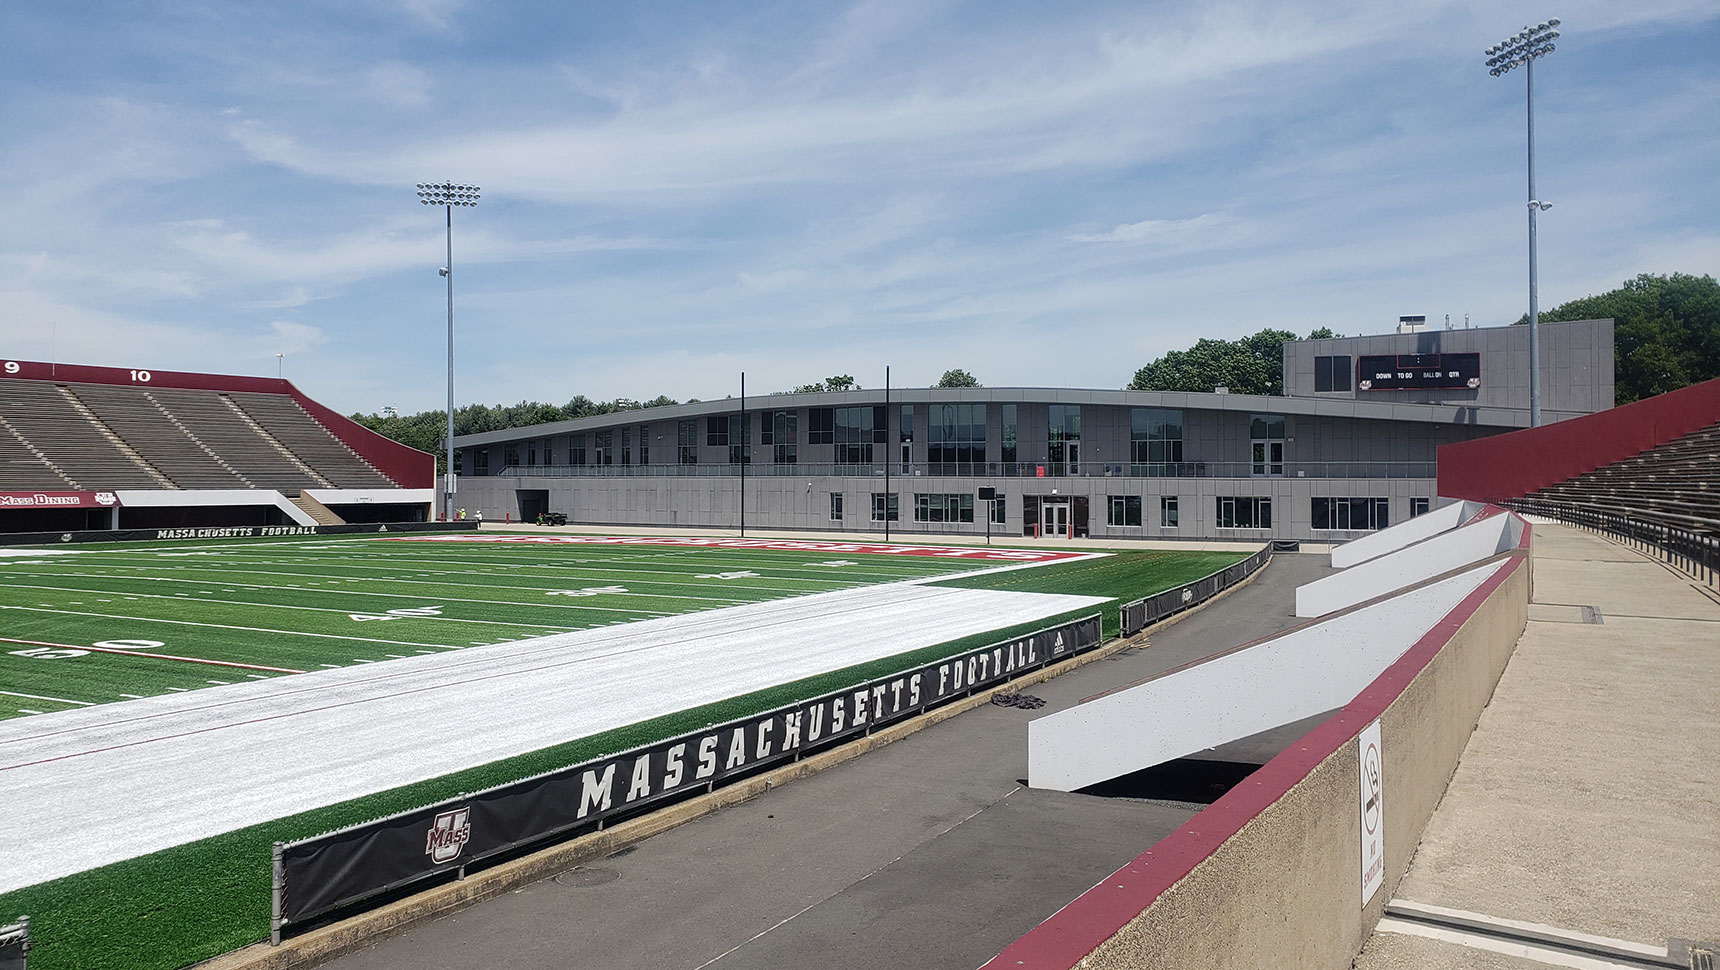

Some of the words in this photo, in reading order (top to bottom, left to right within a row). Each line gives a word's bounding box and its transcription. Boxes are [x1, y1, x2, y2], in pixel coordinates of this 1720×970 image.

[4, 361, 20, 374] 9
[130, 370, 151, 382] 10
[157, 528, 253, 539] MASSACHUSETTS
[261, 526, 317, 536] FOOTBALL
[348, 608, 443, 622] 40
[8, 639, 165, 660] 50
[577, 673, 921, 819] MASSACHUSETTS
[938, 638, 1036, 696] FOOTBALL
